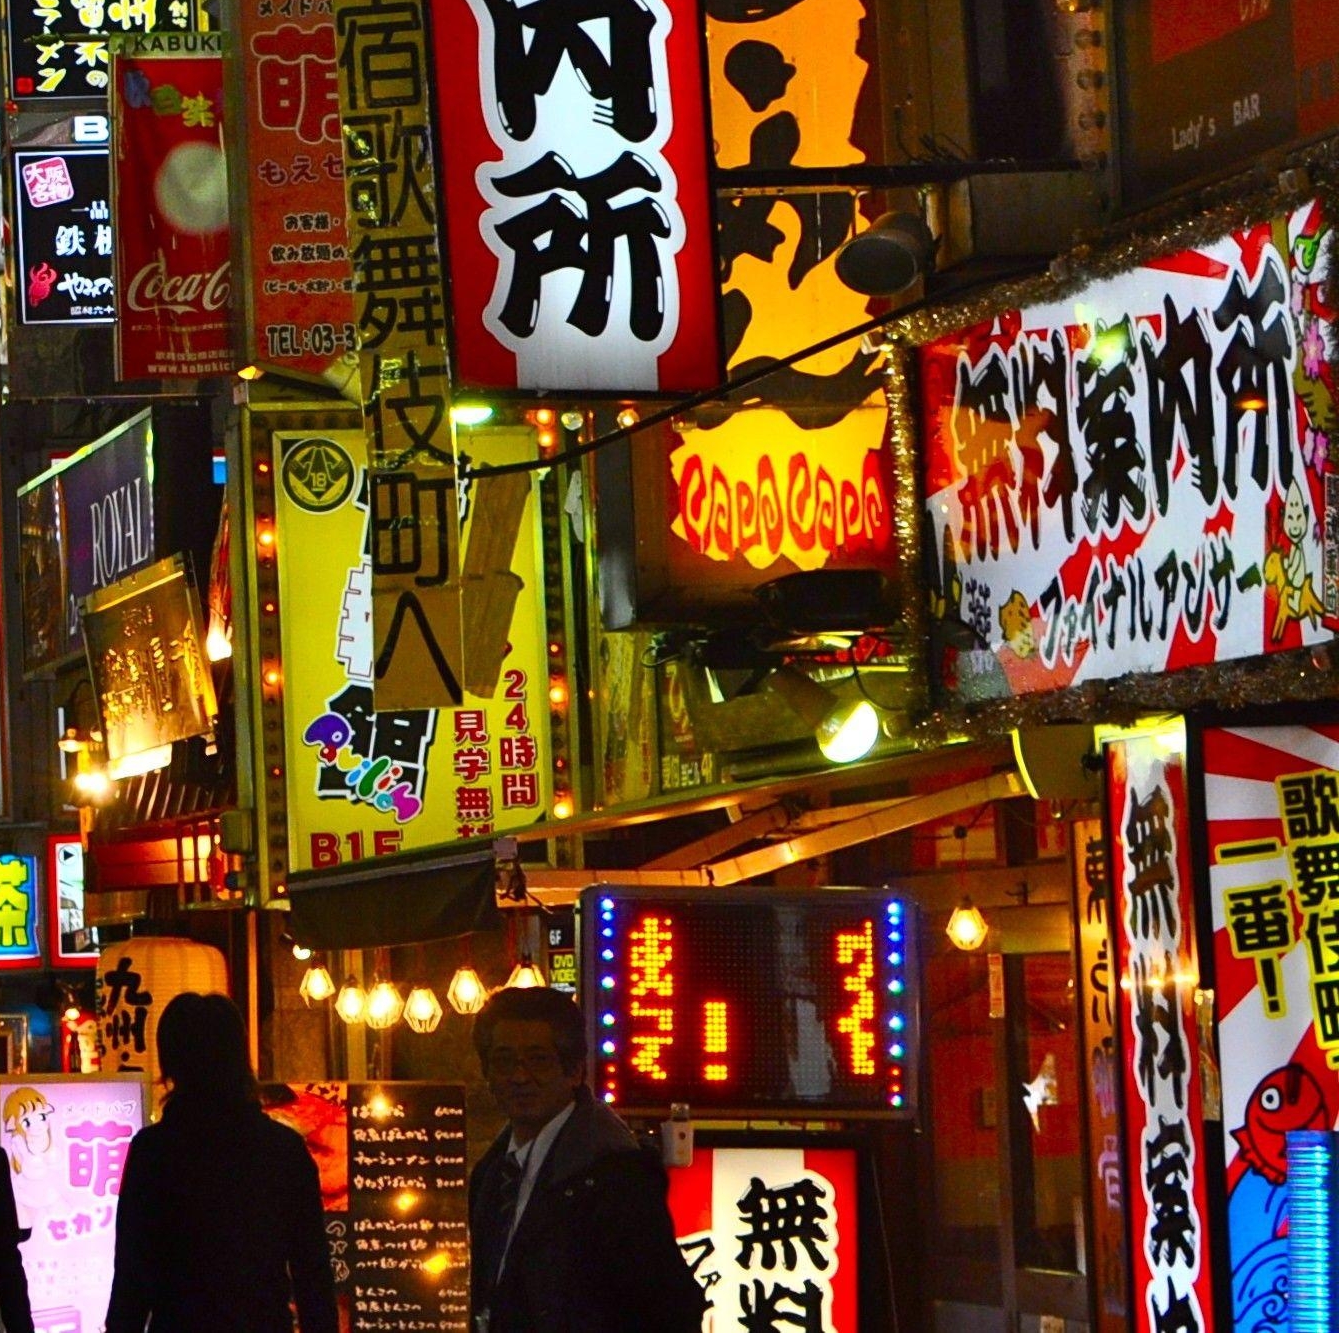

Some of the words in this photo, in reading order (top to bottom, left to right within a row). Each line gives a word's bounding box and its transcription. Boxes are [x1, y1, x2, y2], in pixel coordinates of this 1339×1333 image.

[1172, 115, 1216, 151] Lady's
[1233, 94, 1261, 127] BAR
[955, 254, 1295, 562] 無料案内所
[92, 479, 150, 587] ROYAL
[1040, 534, 1261, 667] ファイナルアンサー
[500, 671, 537, 808] 24時間
